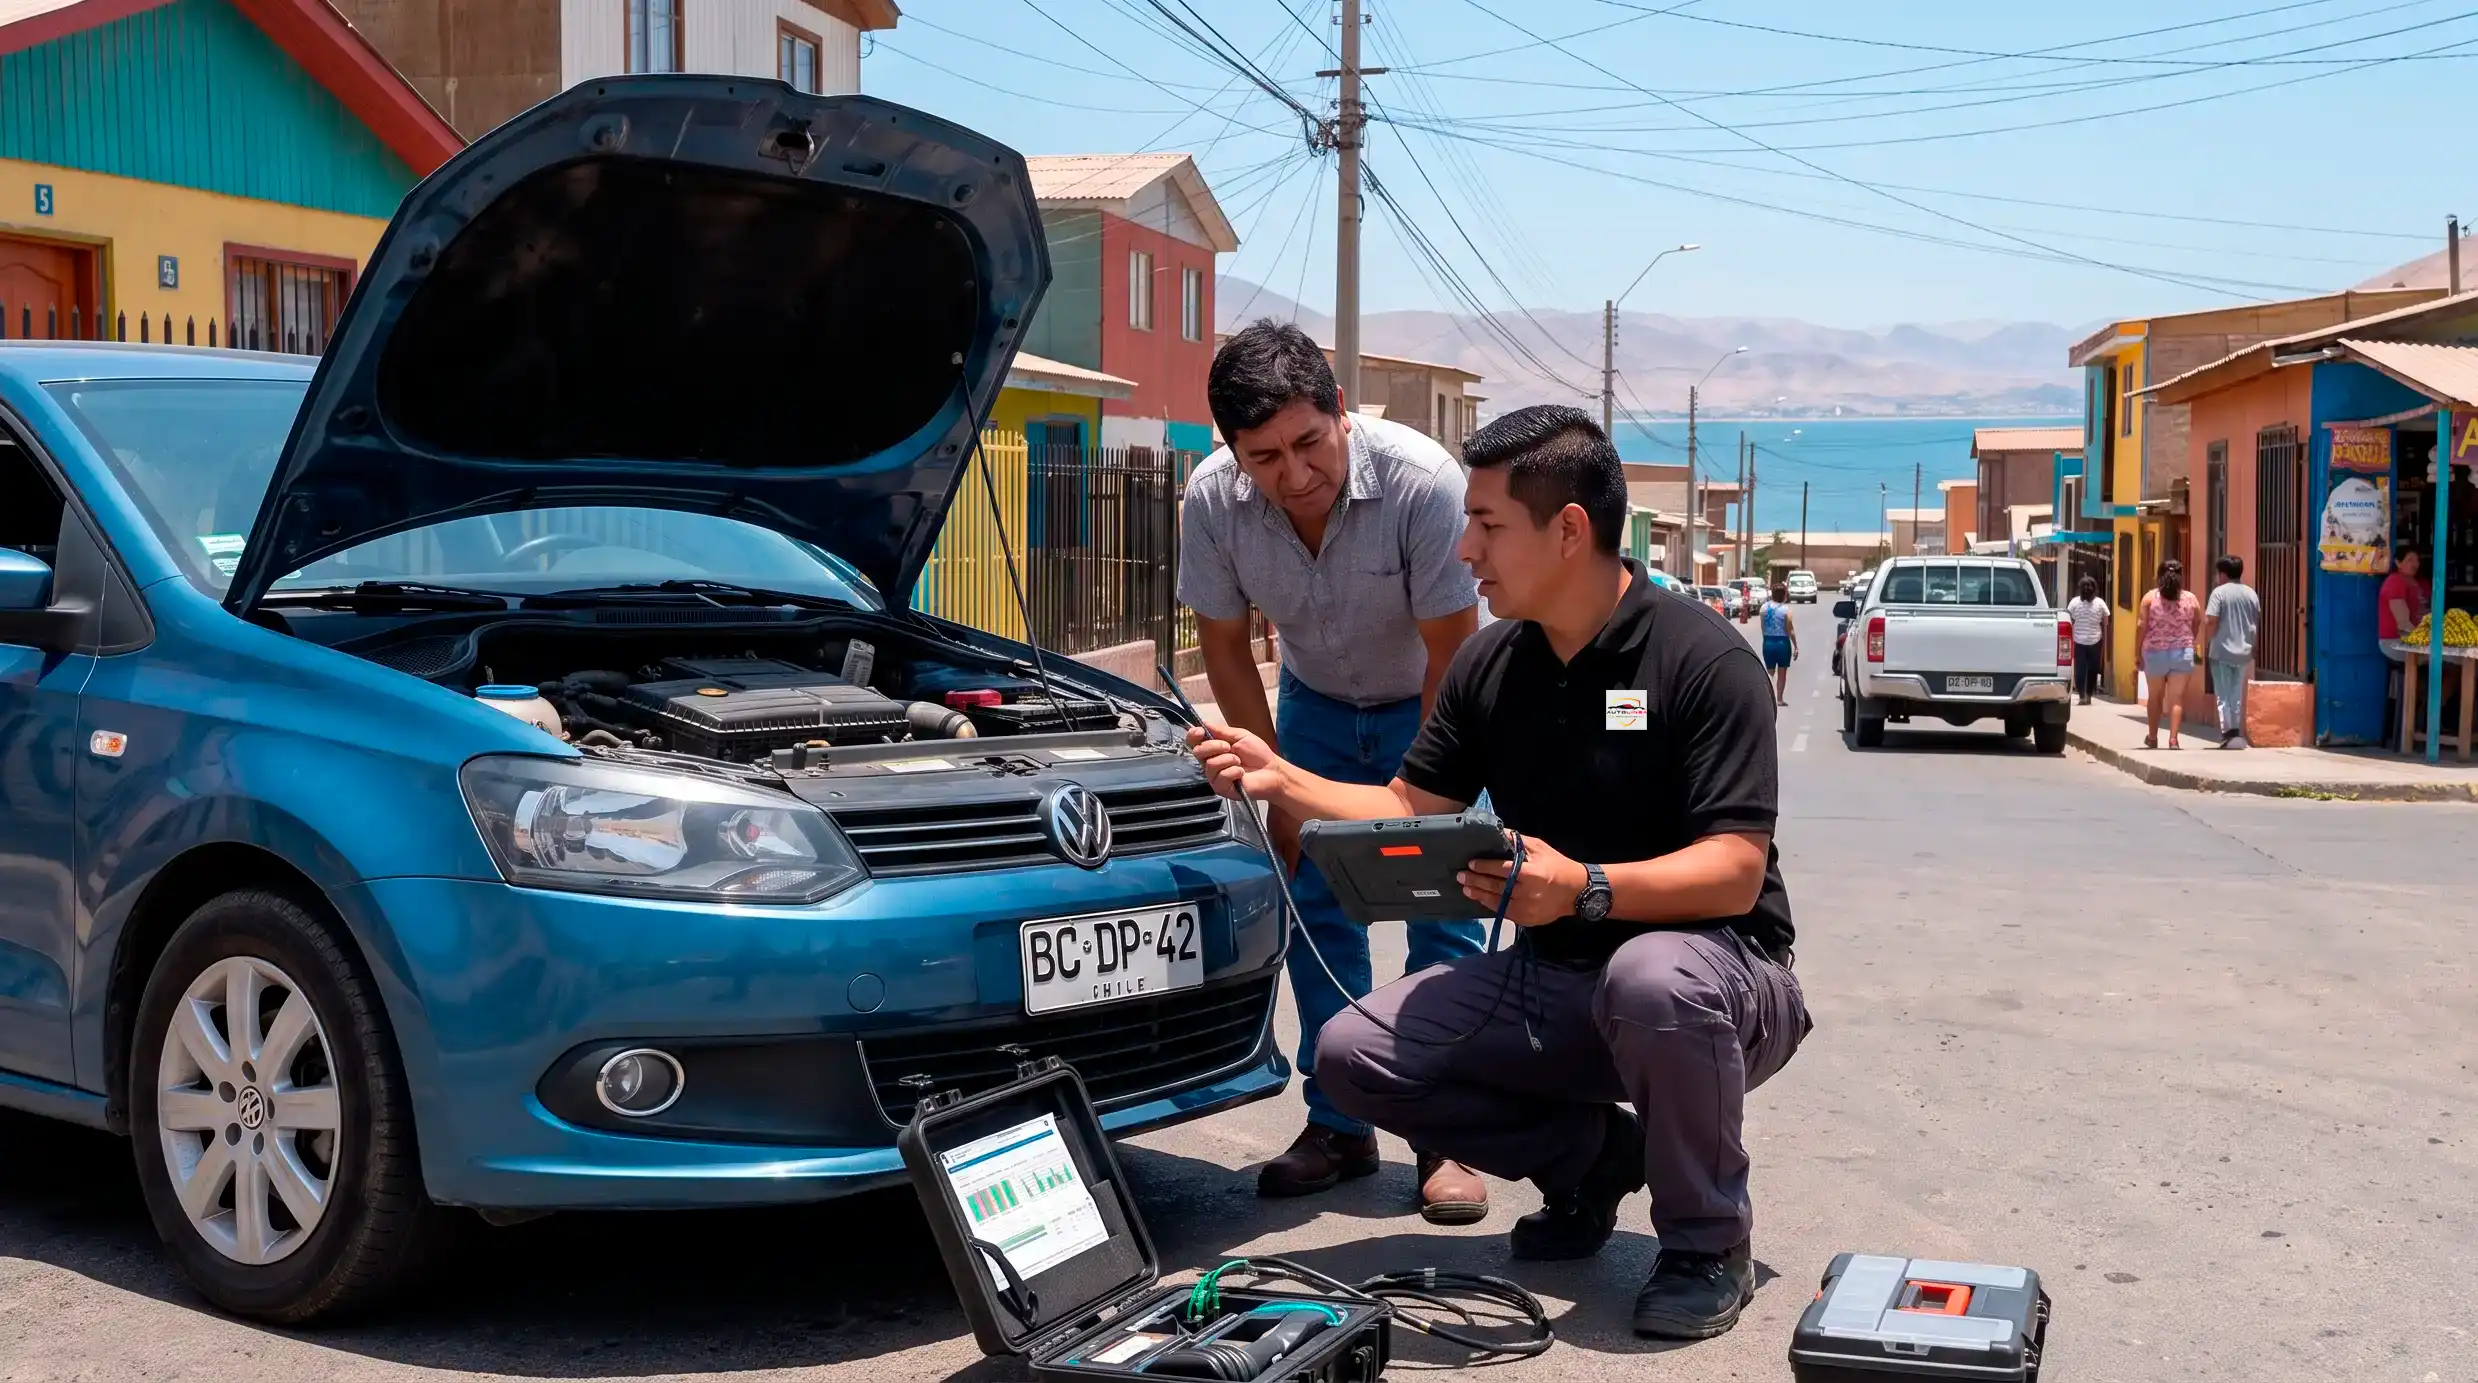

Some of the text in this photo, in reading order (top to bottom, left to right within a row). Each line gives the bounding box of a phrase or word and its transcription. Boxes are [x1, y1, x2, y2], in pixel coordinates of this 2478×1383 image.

[40, 188, 49, 212] 5
[2457, 417, 2478, 458] A
[1093, 977, 1145, 999] CHILE
